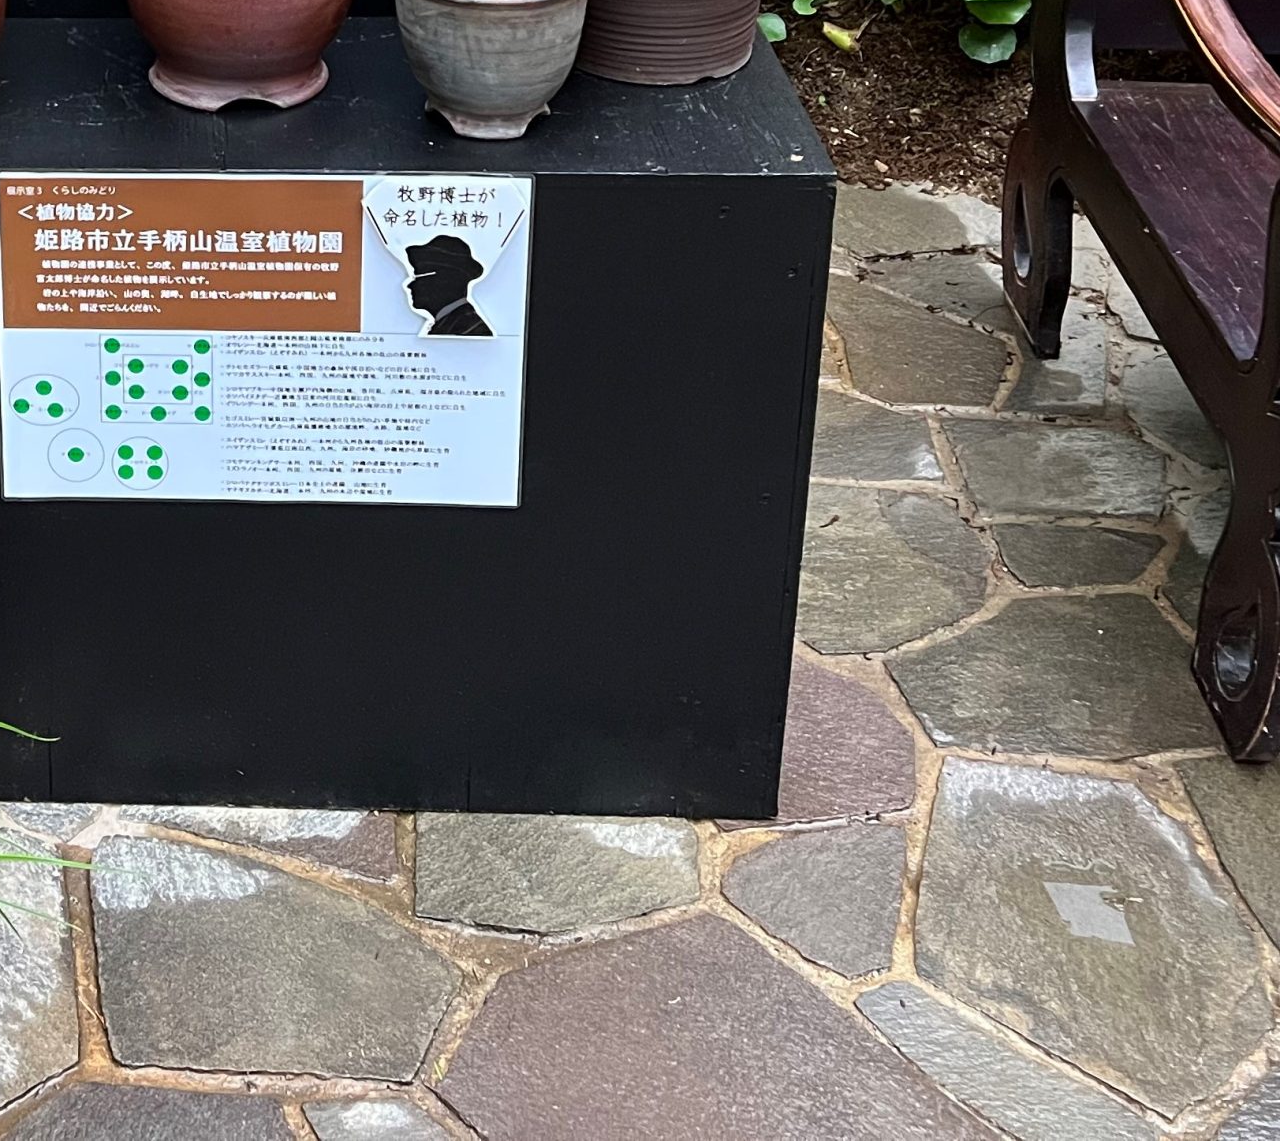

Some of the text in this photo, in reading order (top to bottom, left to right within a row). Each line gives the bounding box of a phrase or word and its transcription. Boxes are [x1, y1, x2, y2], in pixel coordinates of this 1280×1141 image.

[52, 186, 116, 196] くらしのみどり
[396, 185, 496, 204] 牧野博士が
[33, 229, 343, 254] 姫路市立手柄山温室植物園
